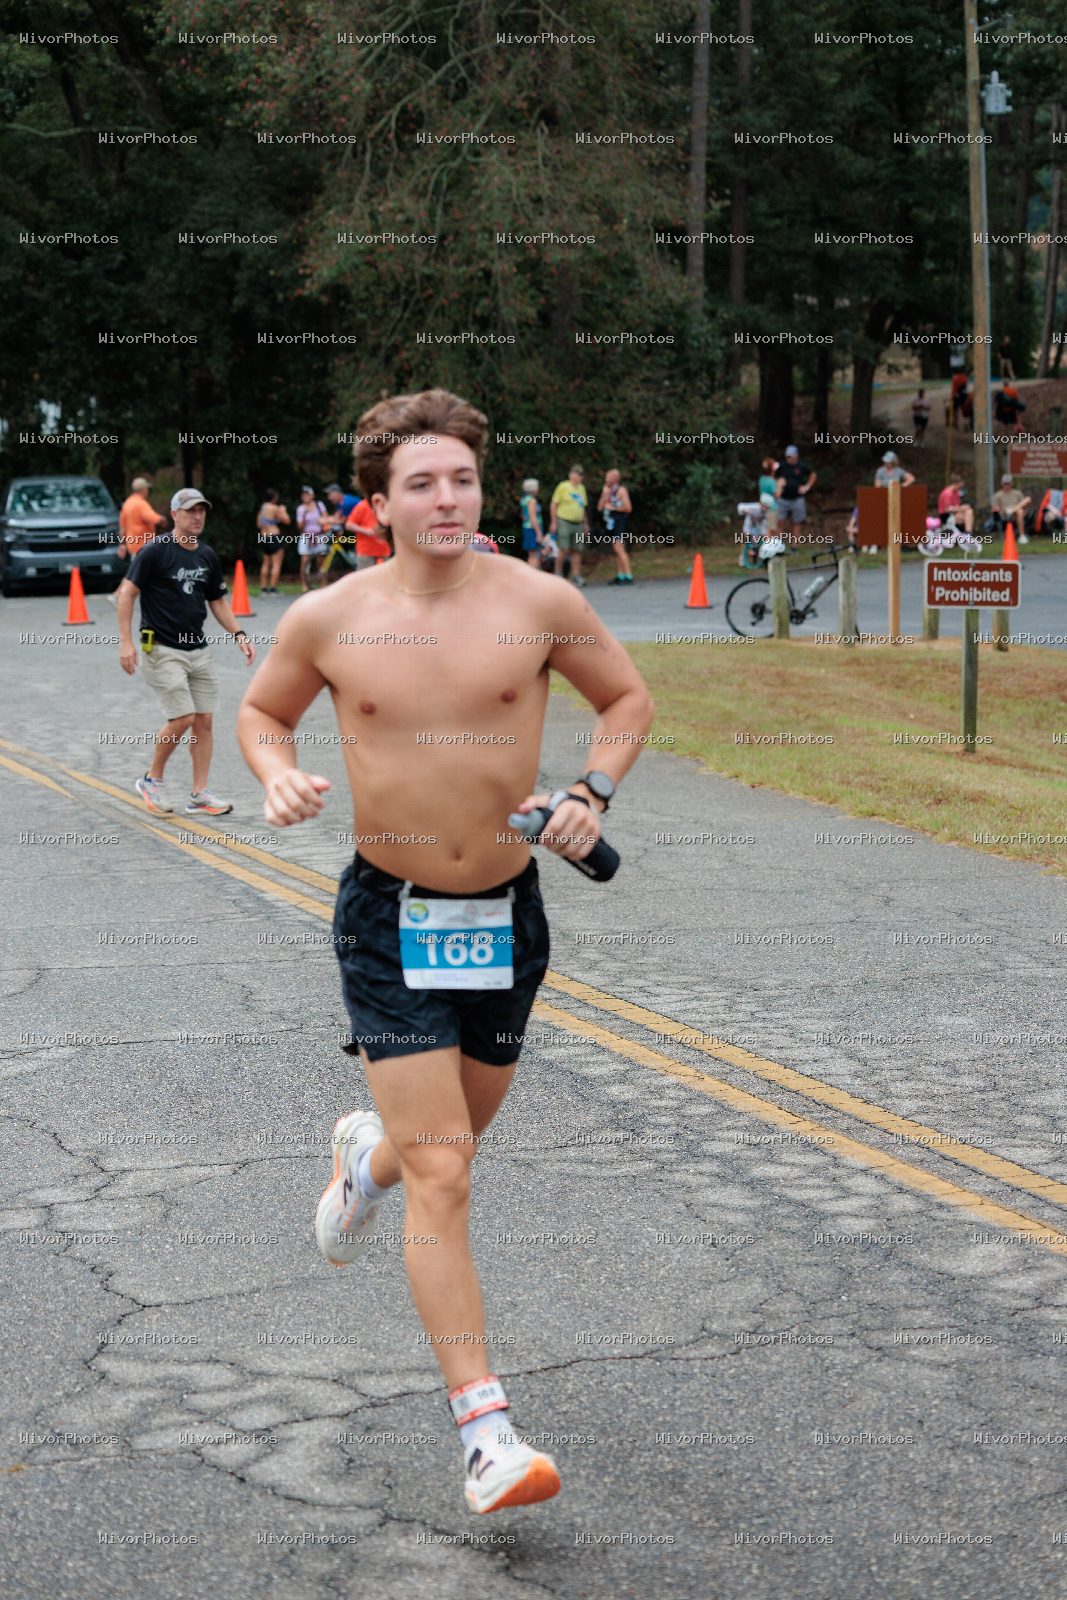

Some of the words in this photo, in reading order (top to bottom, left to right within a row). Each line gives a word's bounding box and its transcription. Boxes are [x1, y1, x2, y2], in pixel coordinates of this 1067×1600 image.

[933, 567, 1012, 583] Intoxicants
[935, 587, 1010, 602] Prohibited
[424, 931, 494, 966] 168
